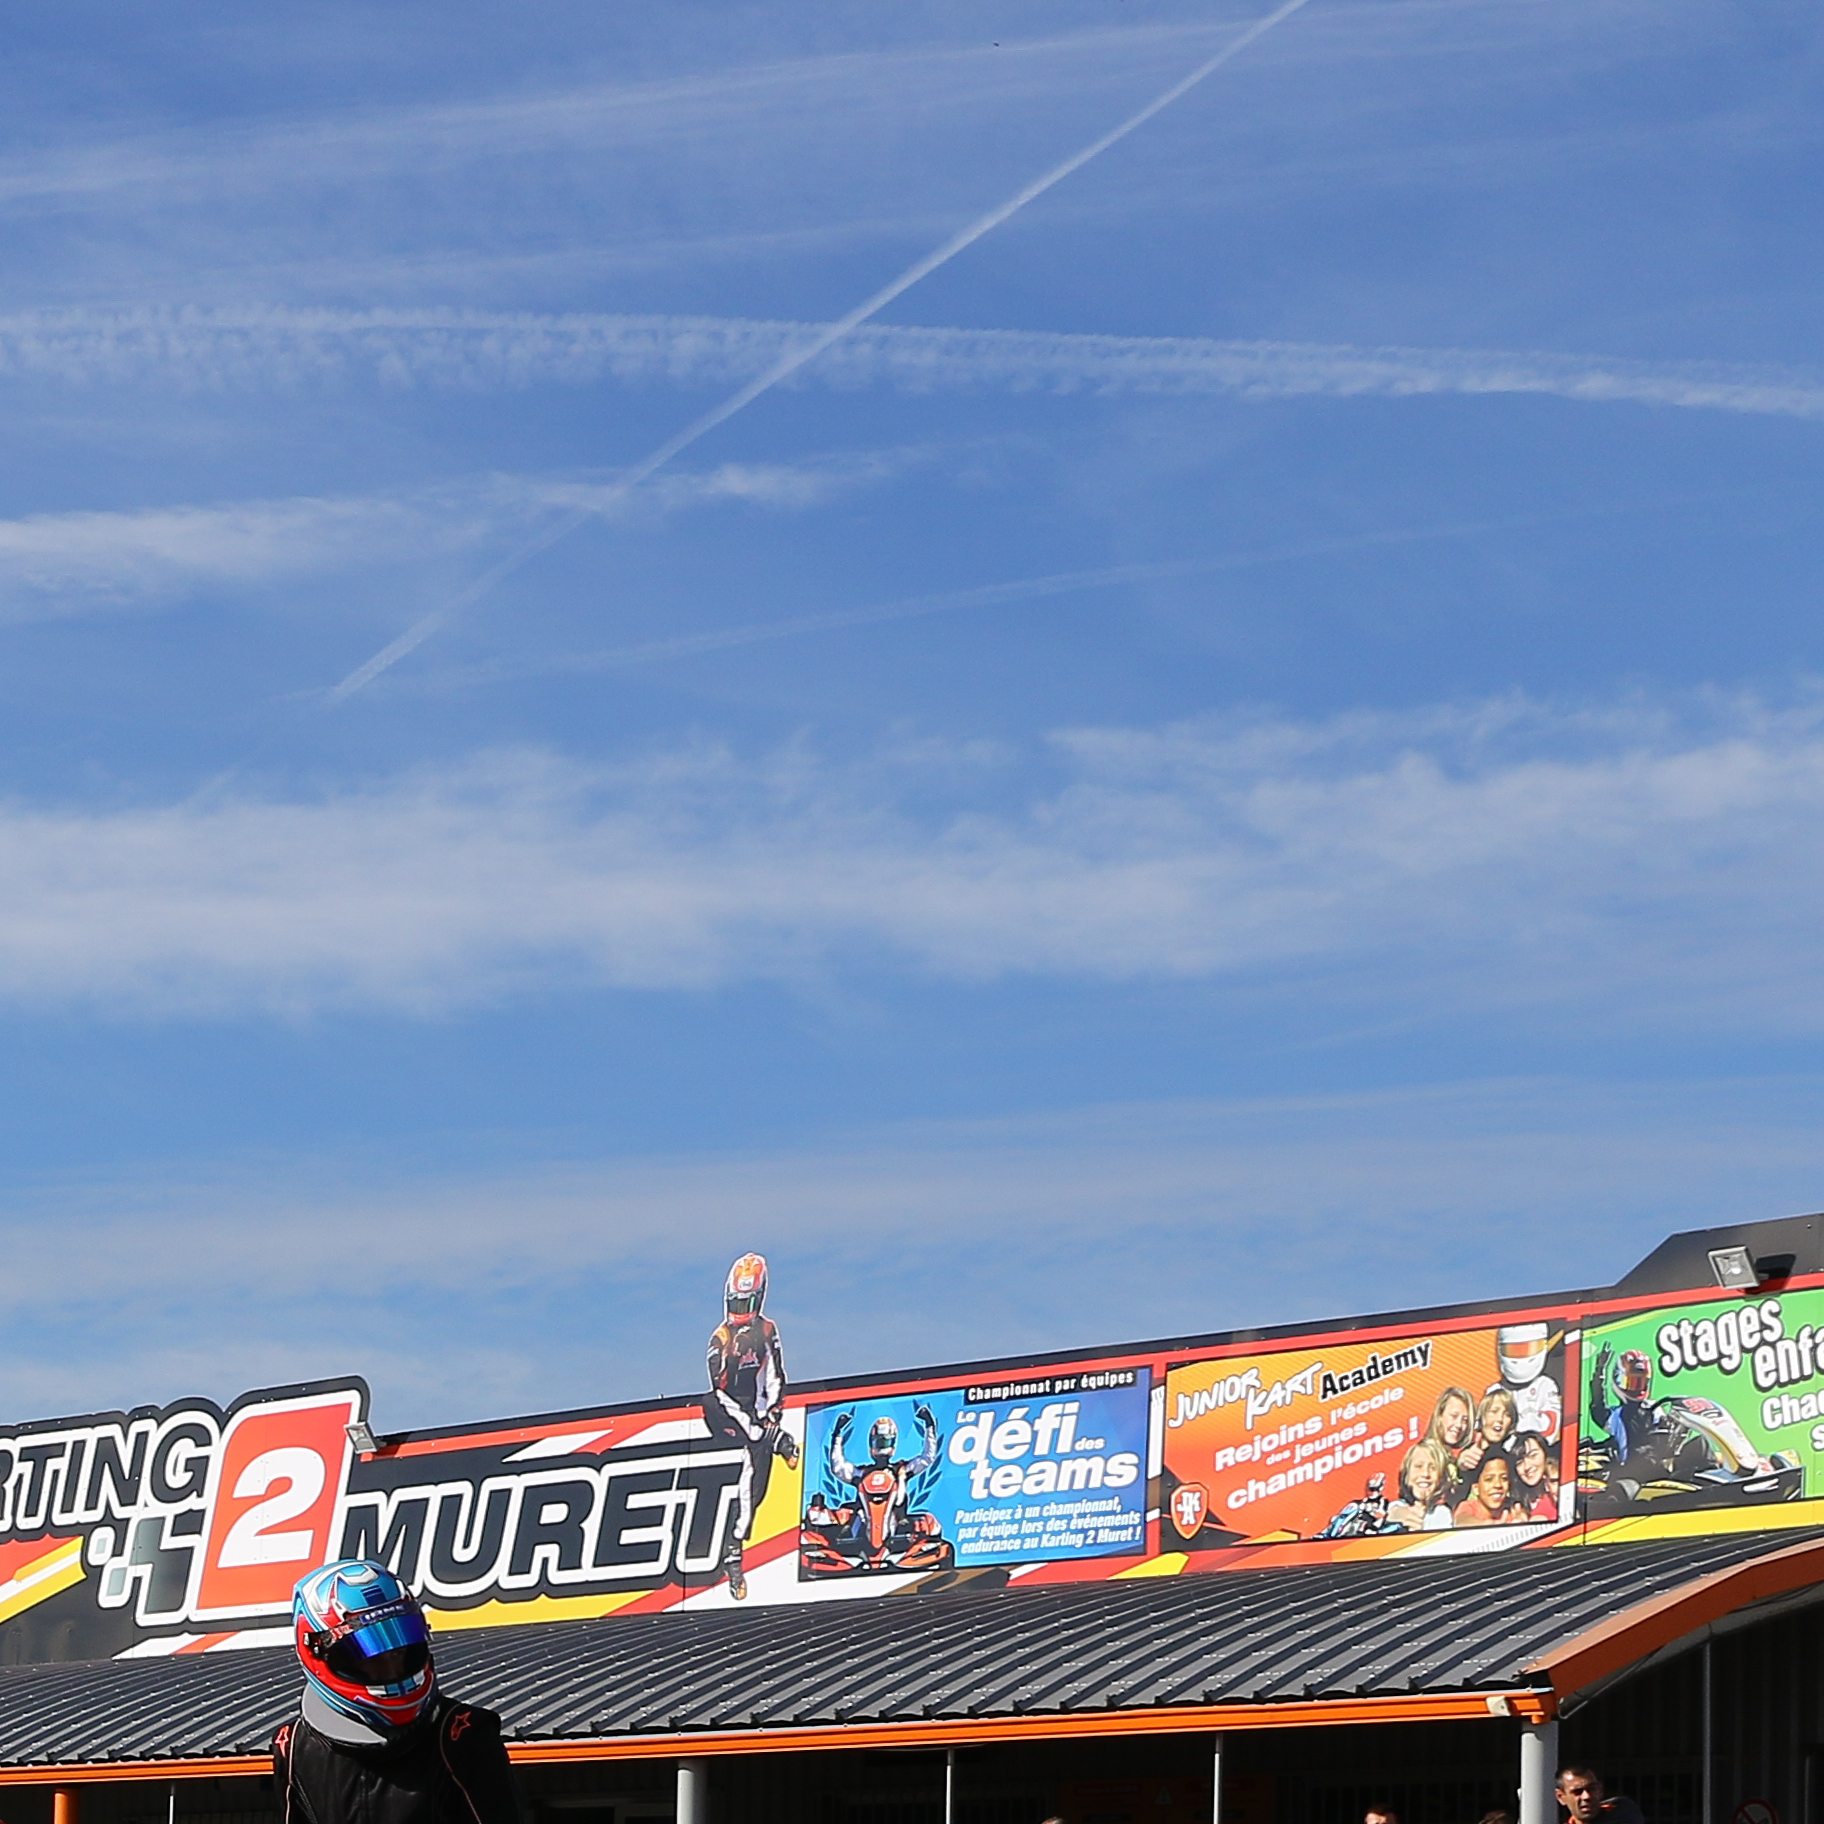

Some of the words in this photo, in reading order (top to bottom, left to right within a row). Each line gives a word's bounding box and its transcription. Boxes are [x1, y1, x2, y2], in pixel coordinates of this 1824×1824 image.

[1657, 1299, 1784, 1374] Stages
[968, 1377, 1051, 1401] Championnat
[1055, 1377, 1076, 1394] par
[1080, 1371, 1134, 1390] équipes
[1168, 1367, 1262, 1428] JUNIOR
[1244, 1361, 1323, 1430] KART
[1319, 1339, 1433, 1401] Academy
[948, 1402, 1080, 1466] défi
[1074, 1436, 1105, 1451] des
[956, 1409, 976, 1424] Le
[1214, 1412, 1323, 1472] Rejoins
[1330, 1386, 1405, 1427] l'école
[1226, 1426, 1405, 1510] champions
[1408, 1416, 1421, 1440] !
[1266, 1447, 1291, 1467] des
[1293, 1422, 1367, 1465] jeunes
[968, 1452, 1139, 1500] teams
[215, 1446, 326, 1570] 2
[340, 1449, 741, 1594] MURET
[954, 1508, 1012, 1526] Participez
[1014, 1504, 1022, 1519] à
[1025, 1506, 1040, 1519] un
[1042, 1496, 1122, 1517] championnat,
[957, 1525, 979, 1542] par
[980, 1521, 1020, 1541] équipe
[1020, 1518, 1044, 1534] lors
[1046, 1516, 1067, 1532] des
[1069, 1509, 1142, 1528] événements
[959, 1538, 1020, 1556] endurance
[1022, 1536, 1039, 1550] au
[1039, 1532, 1085, 1549] Karting
[1085, 1531, 1095, 1545] 2
[1097, 1527, 1133, 1545] Muret
[1134, 1525, 1142, 1541] !
